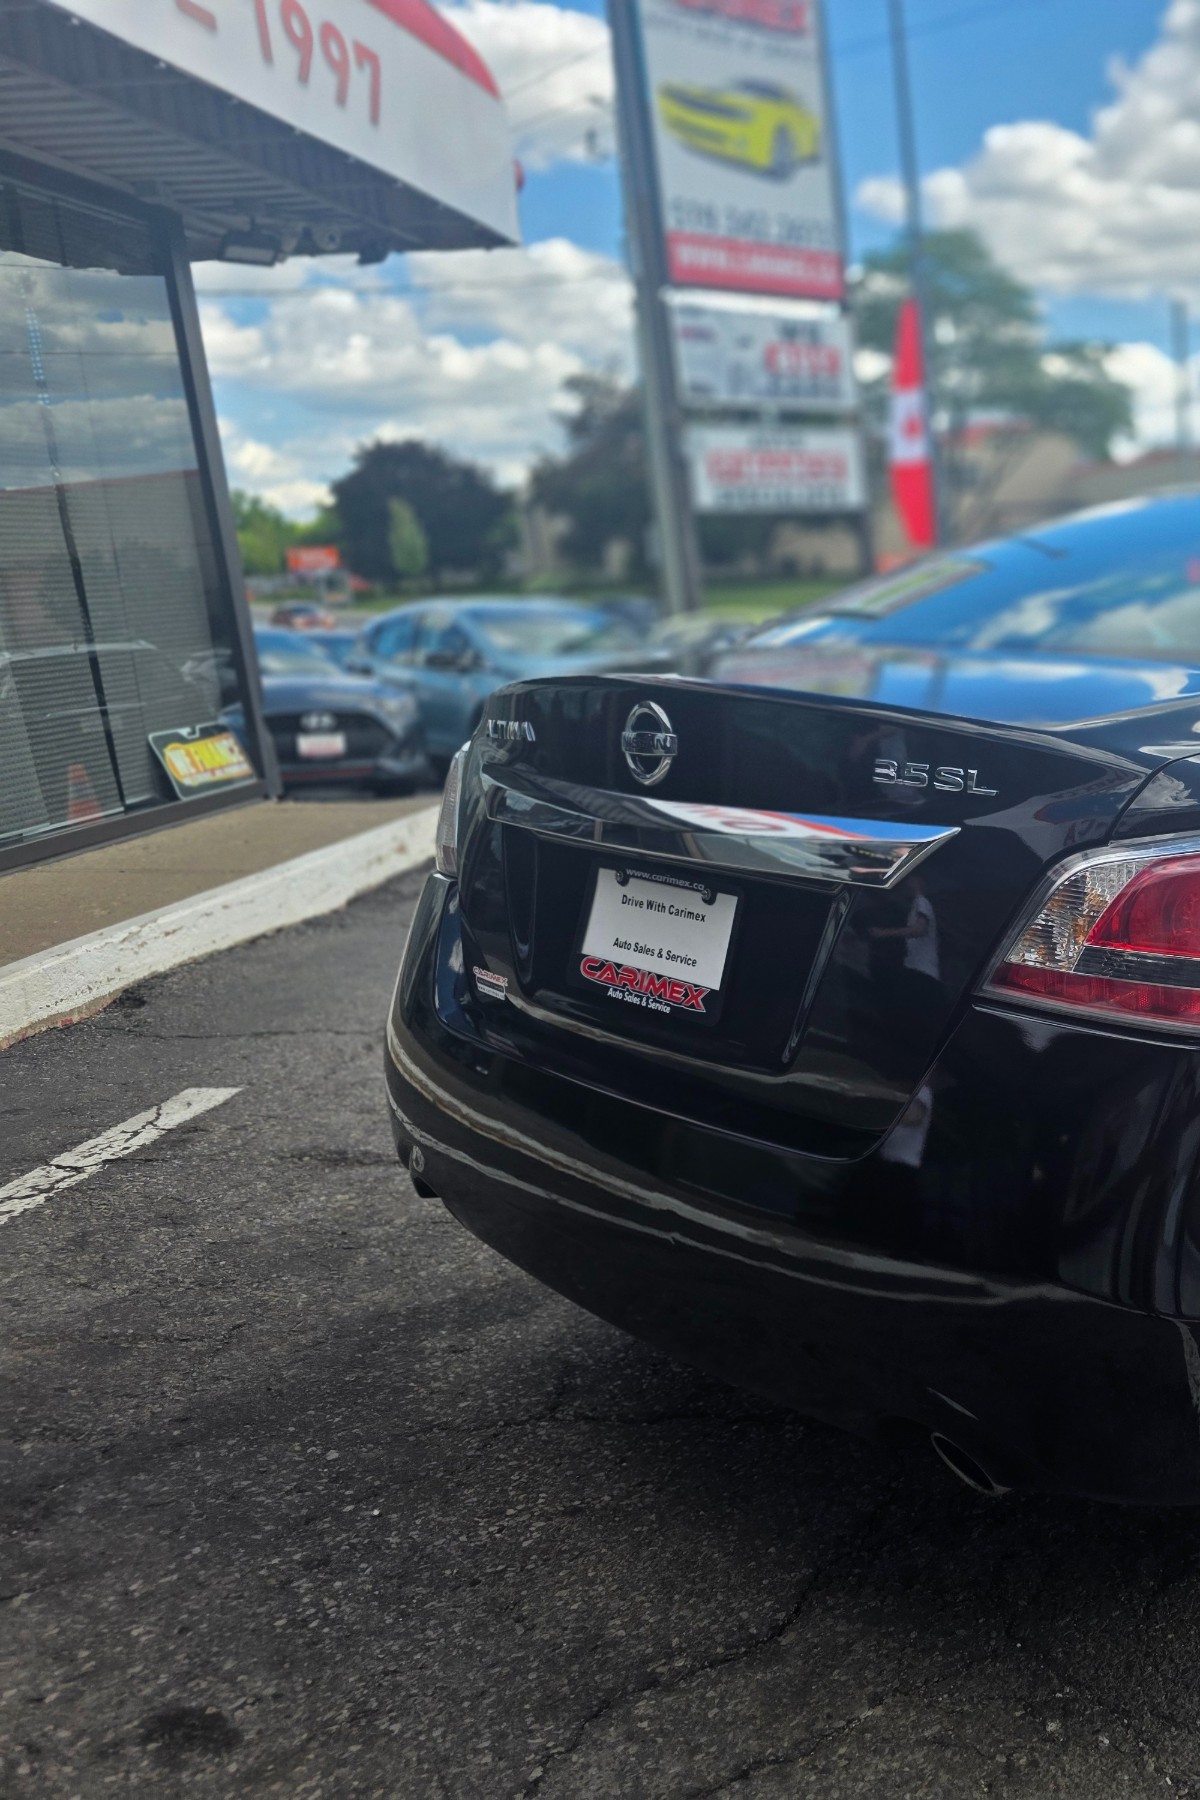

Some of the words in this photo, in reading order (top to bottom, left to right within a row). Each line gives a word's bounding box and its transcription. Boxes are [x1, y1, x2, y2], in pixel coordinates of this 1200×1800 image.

[254, 0, 381, 126] 1997
[625, 868, 705, 891] www.carimex.ca
[621, 894, 644, 909] Drive
[646, 899, 666, 914] With
[668, 904, 706, 923] Carimex
[612, 937, 632, 951] Auto
[633, 942, 656, 957] Sales
[656, 948, 664, 959] &
[665, 950, 697, 967] Service
[580, 956, 711, 1012] CARIMEX
[607, 987, 623, 999] Auto
[623, 991, 641, 1005] Sales
[641, 996, 648, 1007] &
[647, 998, 671, 1014] Service
